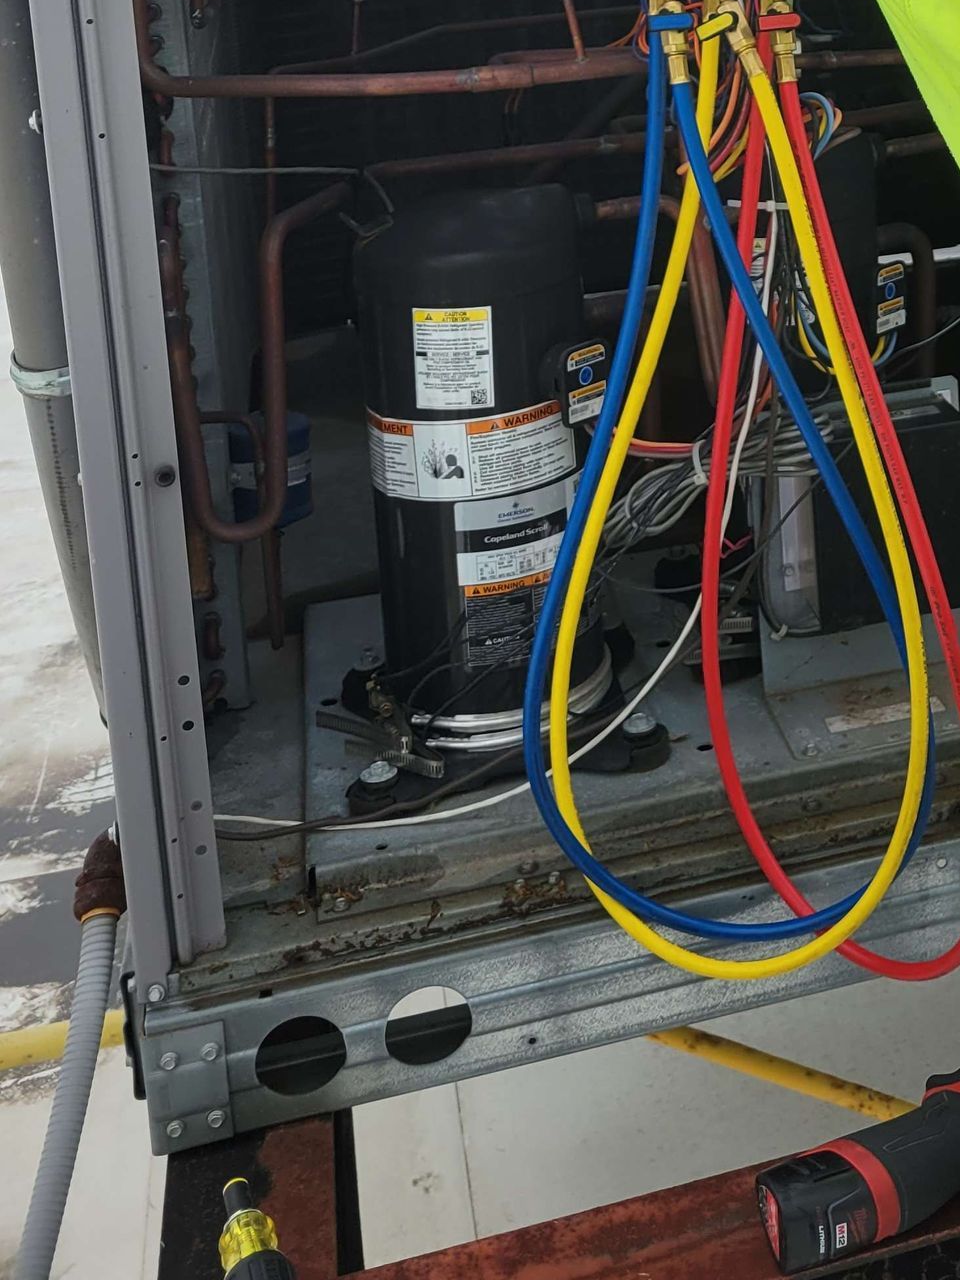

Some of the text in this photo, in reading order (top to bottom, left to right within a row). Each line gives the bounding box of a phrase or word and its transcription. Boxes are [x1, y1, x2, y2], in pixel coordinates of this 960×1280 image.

[503, 405, 553, 427] WARNING
[498, 506, 535, 519] EMERSON
[483, 522, 549, 544] Copeland Scroll
[483, 579, 526, 593] WARNING
[837, 1224, 846, 1247] M12
